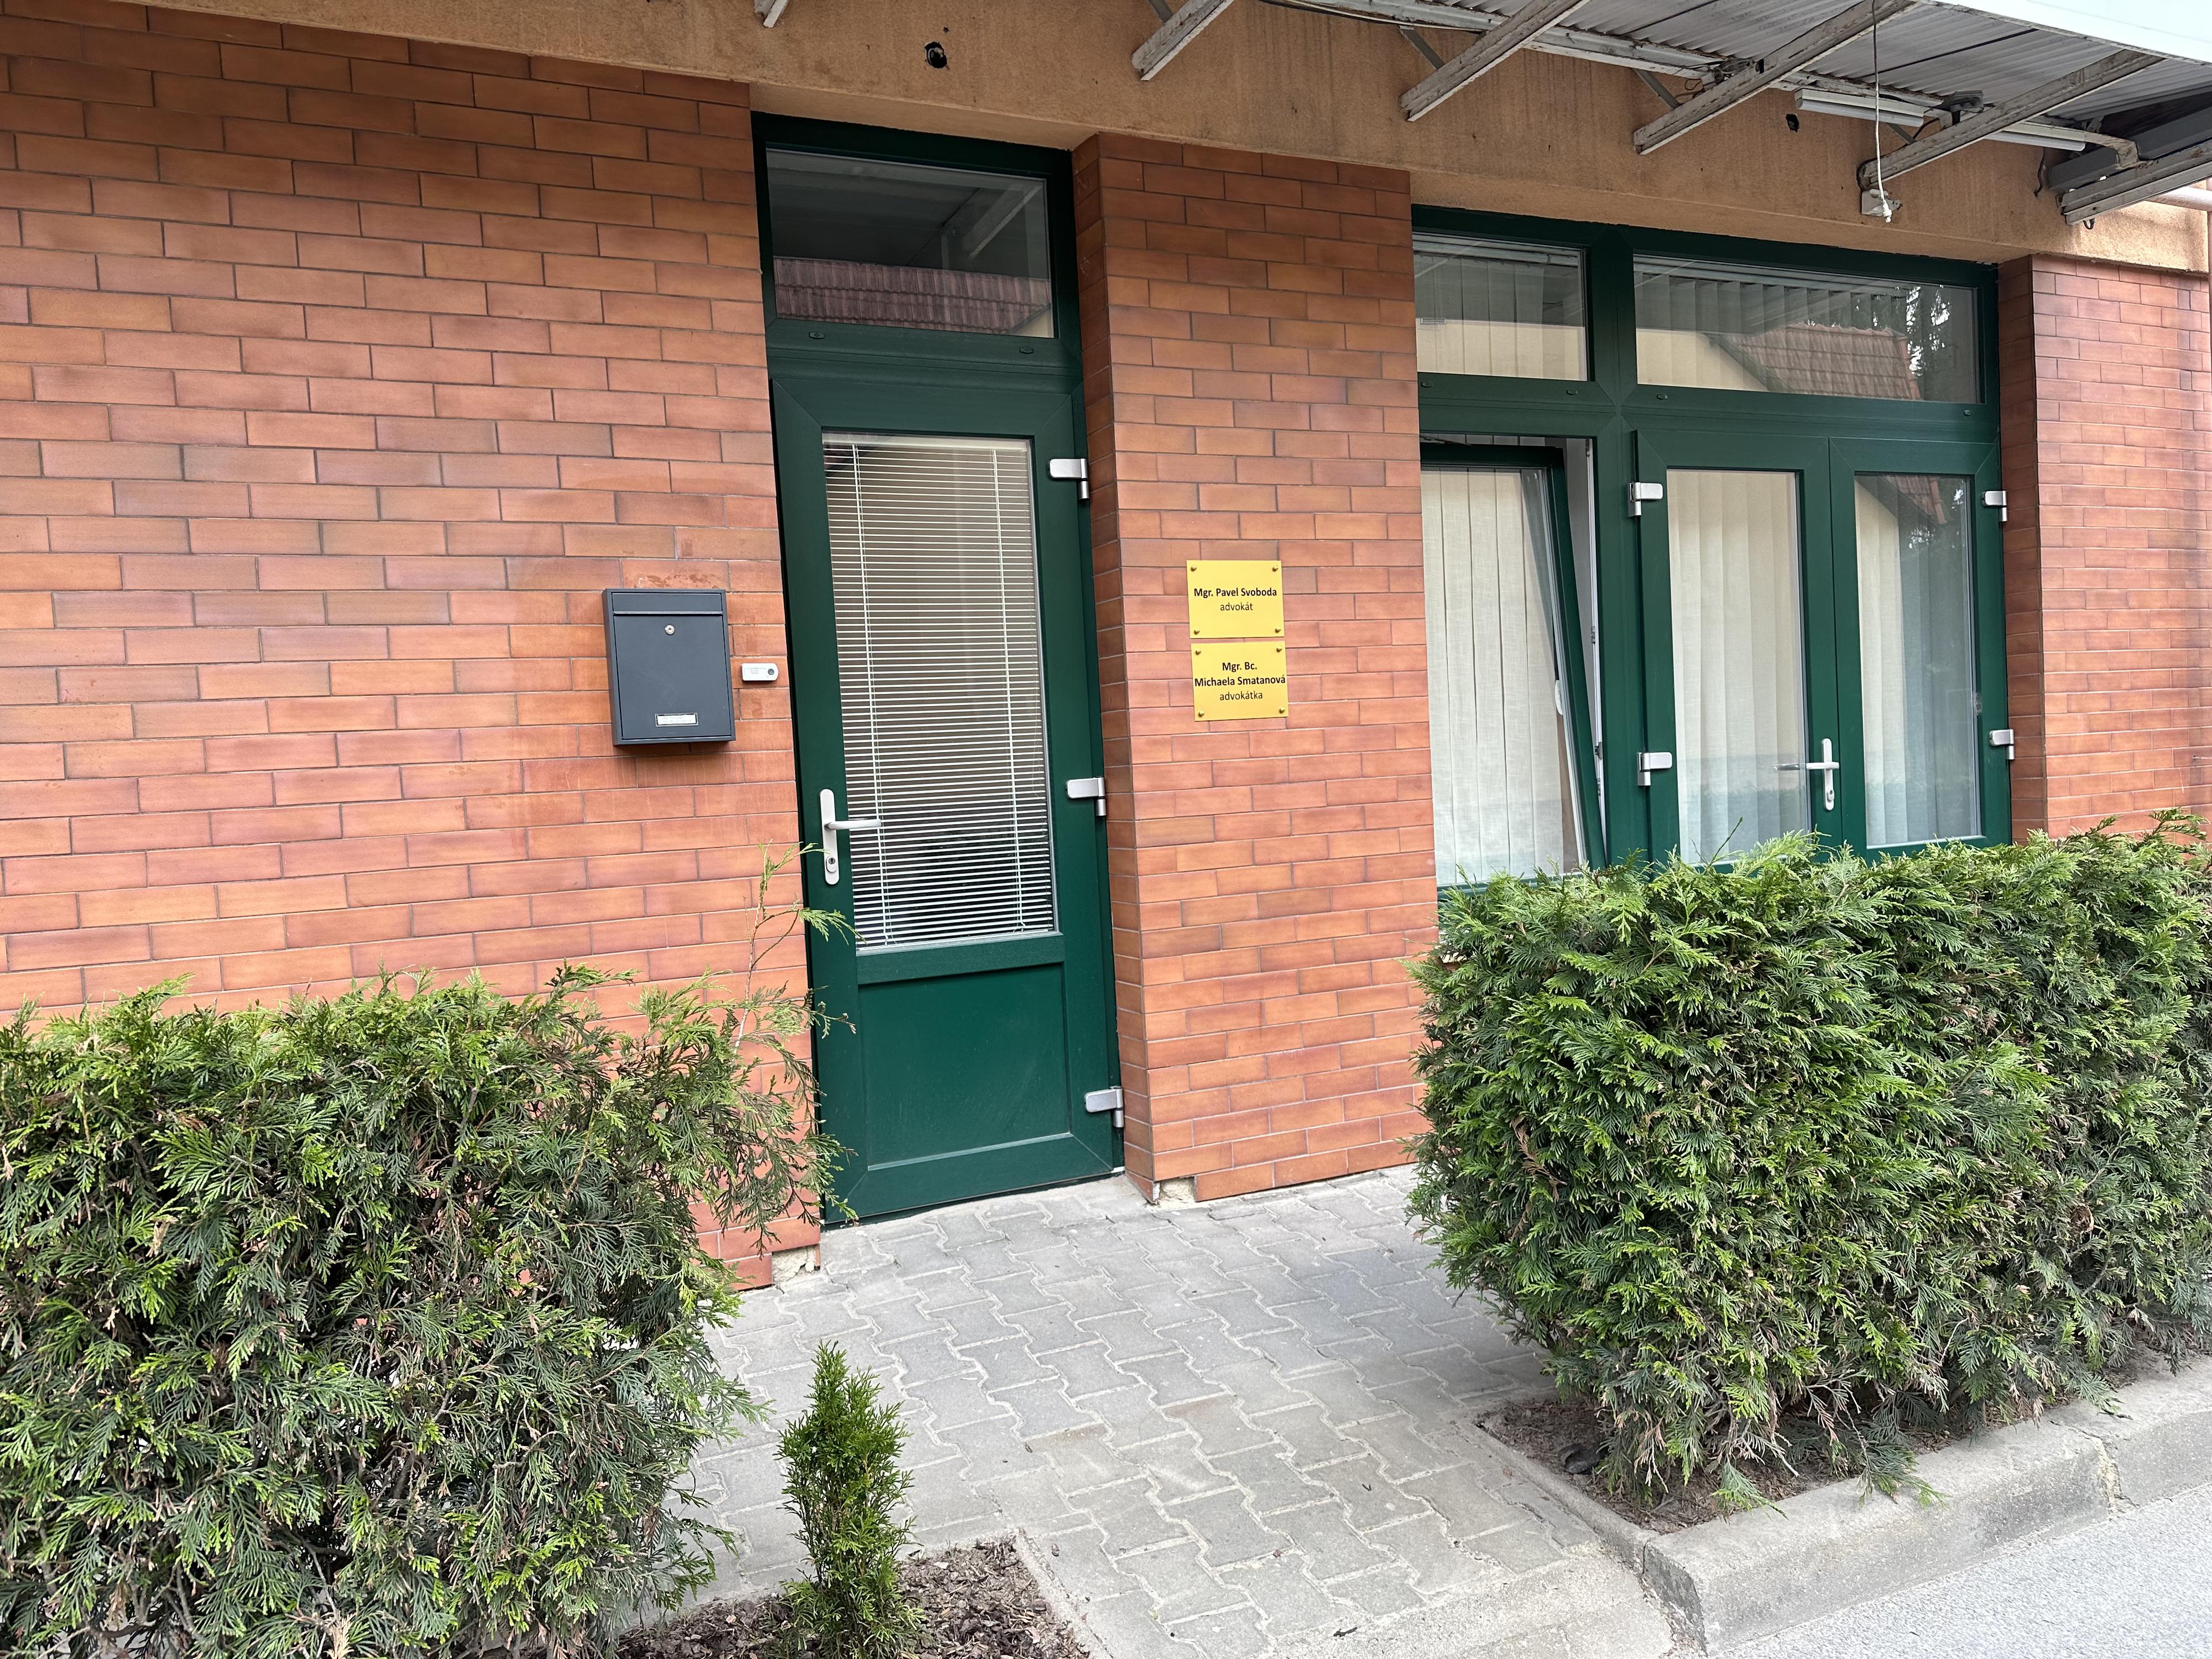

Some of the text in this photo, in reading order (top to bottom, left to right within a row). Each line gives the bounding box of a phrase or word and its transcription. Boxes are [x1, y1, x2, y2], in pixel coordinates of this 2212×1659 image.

[1194, 587, 1277, 598] Mgr. Pavel Svoboda
[1220, 602, 1253, 611] advokát
[1222, 661, 1258, 672] Mgr. Bc.
[1194, 674, 1286, 687] Michaela Smatanová
[1219, 691, 1263, 701] advokátka
